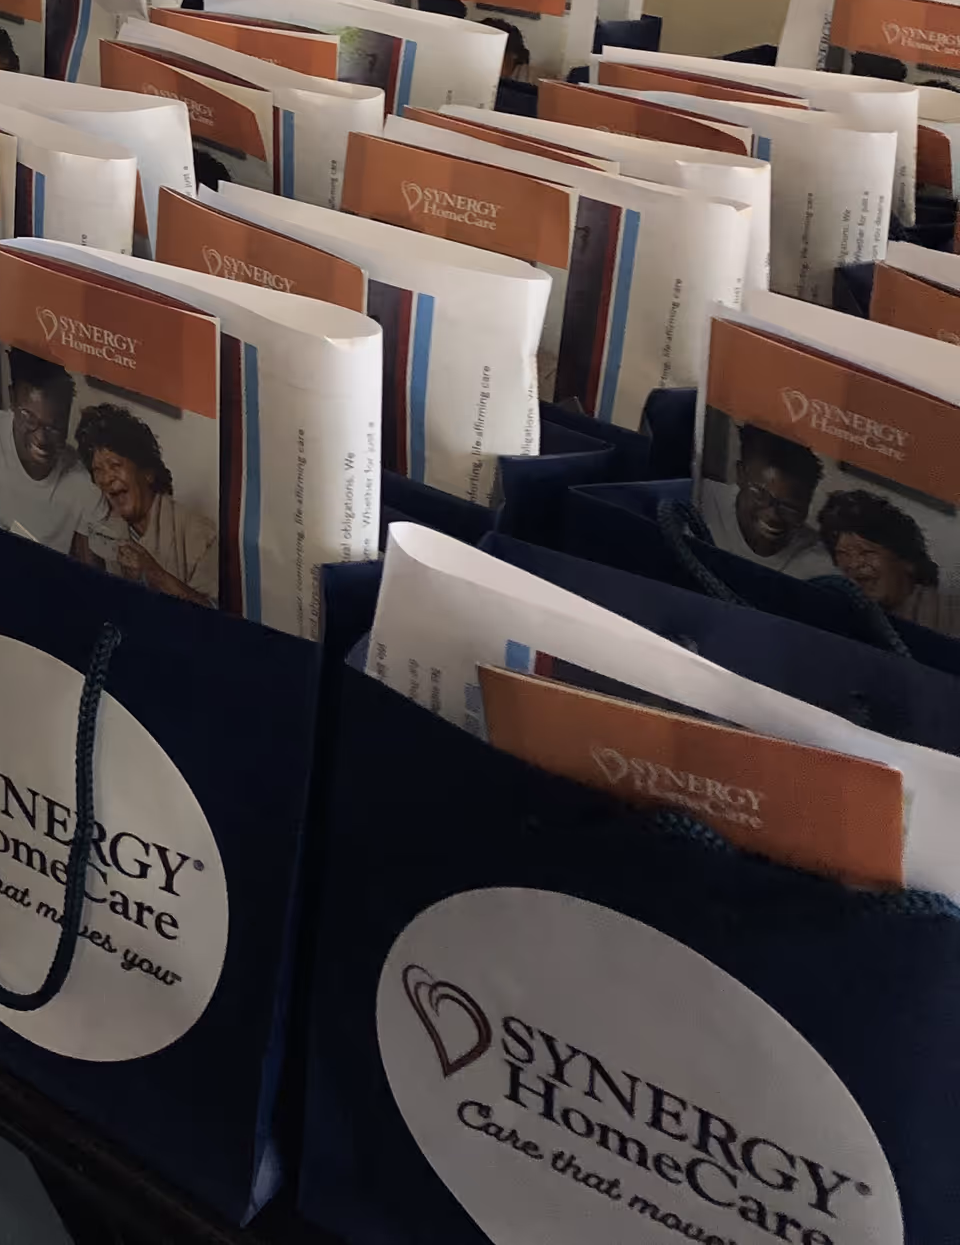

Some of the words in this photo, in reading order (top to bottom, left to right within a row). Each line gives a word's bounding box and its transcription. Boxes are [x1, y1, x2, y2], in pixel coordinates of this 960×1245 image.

[423, 187, 498, 218] SYNERGY
[423, 201, 497, 230] HomeCare
[224, 255, 294, 293] SYNERGY
[60, 316, 137, 354] SYNERGY
[61, 332, 136, 369] HomeCare
[811, 399, 907, 446] SYNERGY
[631, 758, 759, 810] SYNERGY
[36, 901, 117, 954] mes
[120, 947, 178, 987] you
[502, 1015, 851, 1219] SYNERGY
[457, 1099, 545, 1161] Care
[550, 1149, 623, 1203] that
[627, 1193, 737, 1245] mov
[504, 1059, 834, 1245] HomeCare
